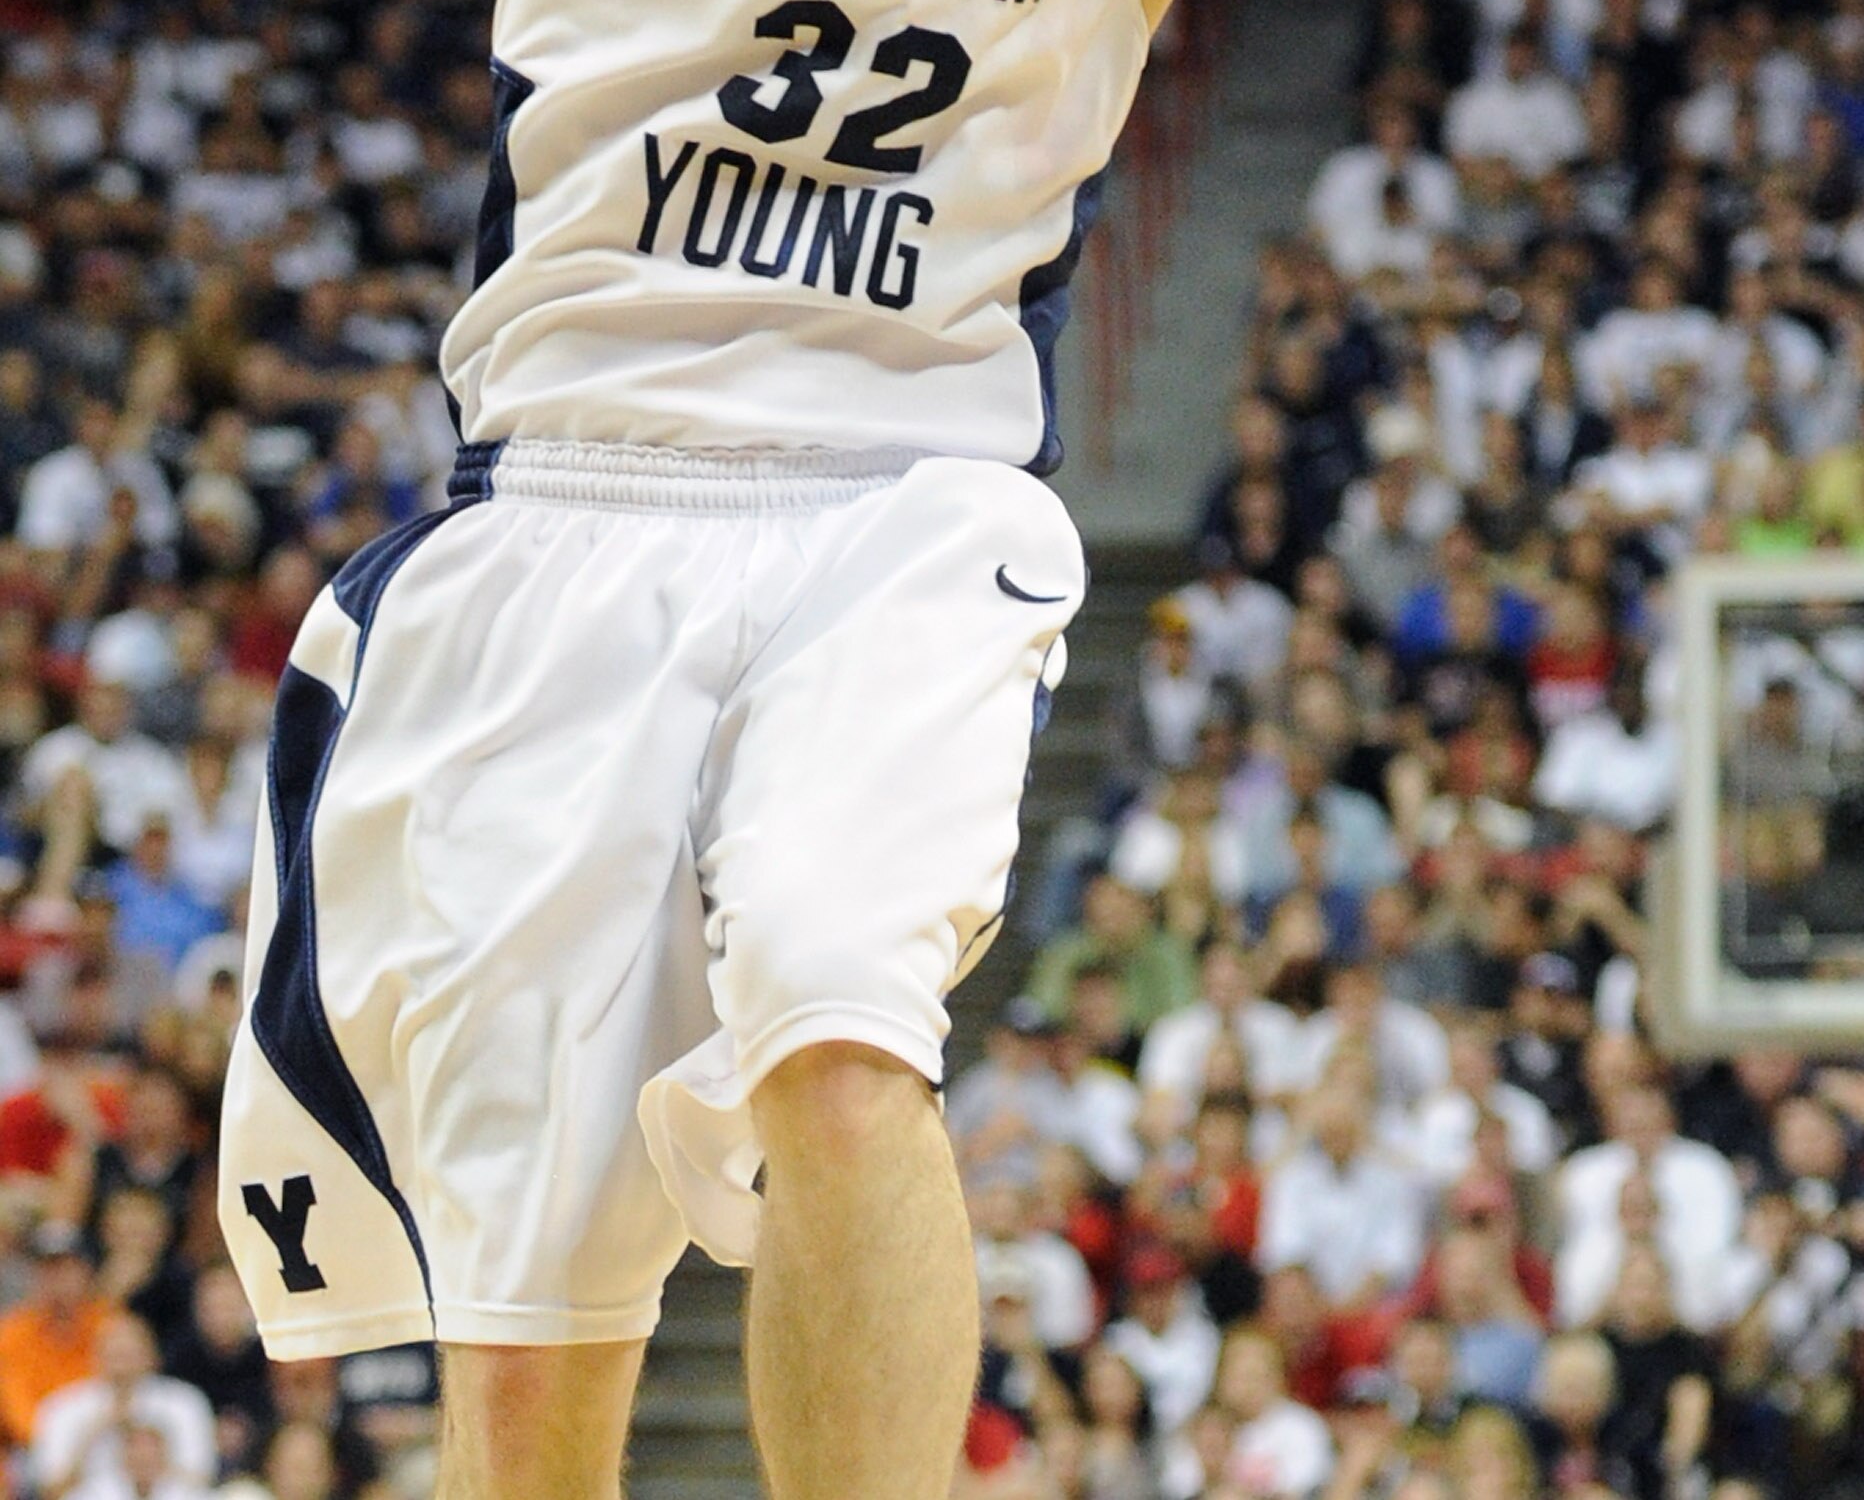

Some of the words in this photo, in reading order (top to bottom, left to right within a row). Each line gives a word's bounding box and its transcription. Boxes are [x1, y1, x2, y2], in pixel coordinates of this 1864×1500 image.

[716, 0, 973, 174] 32
[635, 131, 935, 312] YOUNG
[240, 1174, 328, 1294] Y
